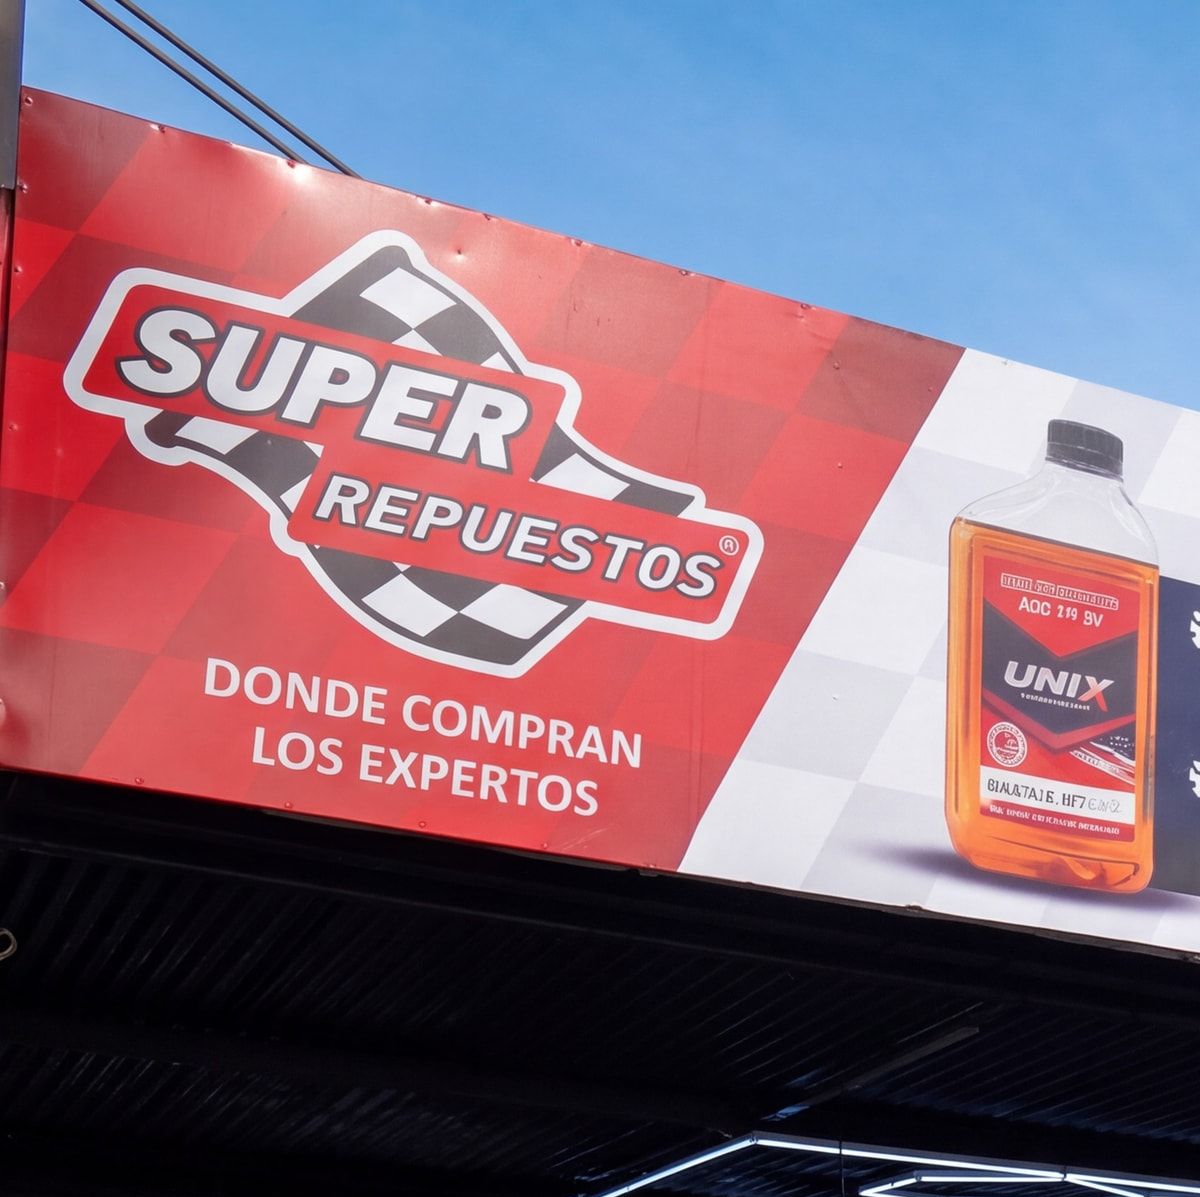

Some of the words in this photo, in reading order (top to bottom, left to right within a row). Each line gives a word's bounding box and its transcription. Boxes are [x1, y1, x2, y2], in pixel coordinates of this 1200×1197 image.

[117, 307, 531, 471] SUPER
[312, 474, 720, 597] REPUESTOS
[204, 658, 387, 725] DONDE
[402, 695, 643, 769] COMPRAN
[1004, 660, 1114, 712] UNIX
[252, 726, 343, 775] LOS
[359, 746, 599, 816] EXPERTOS
